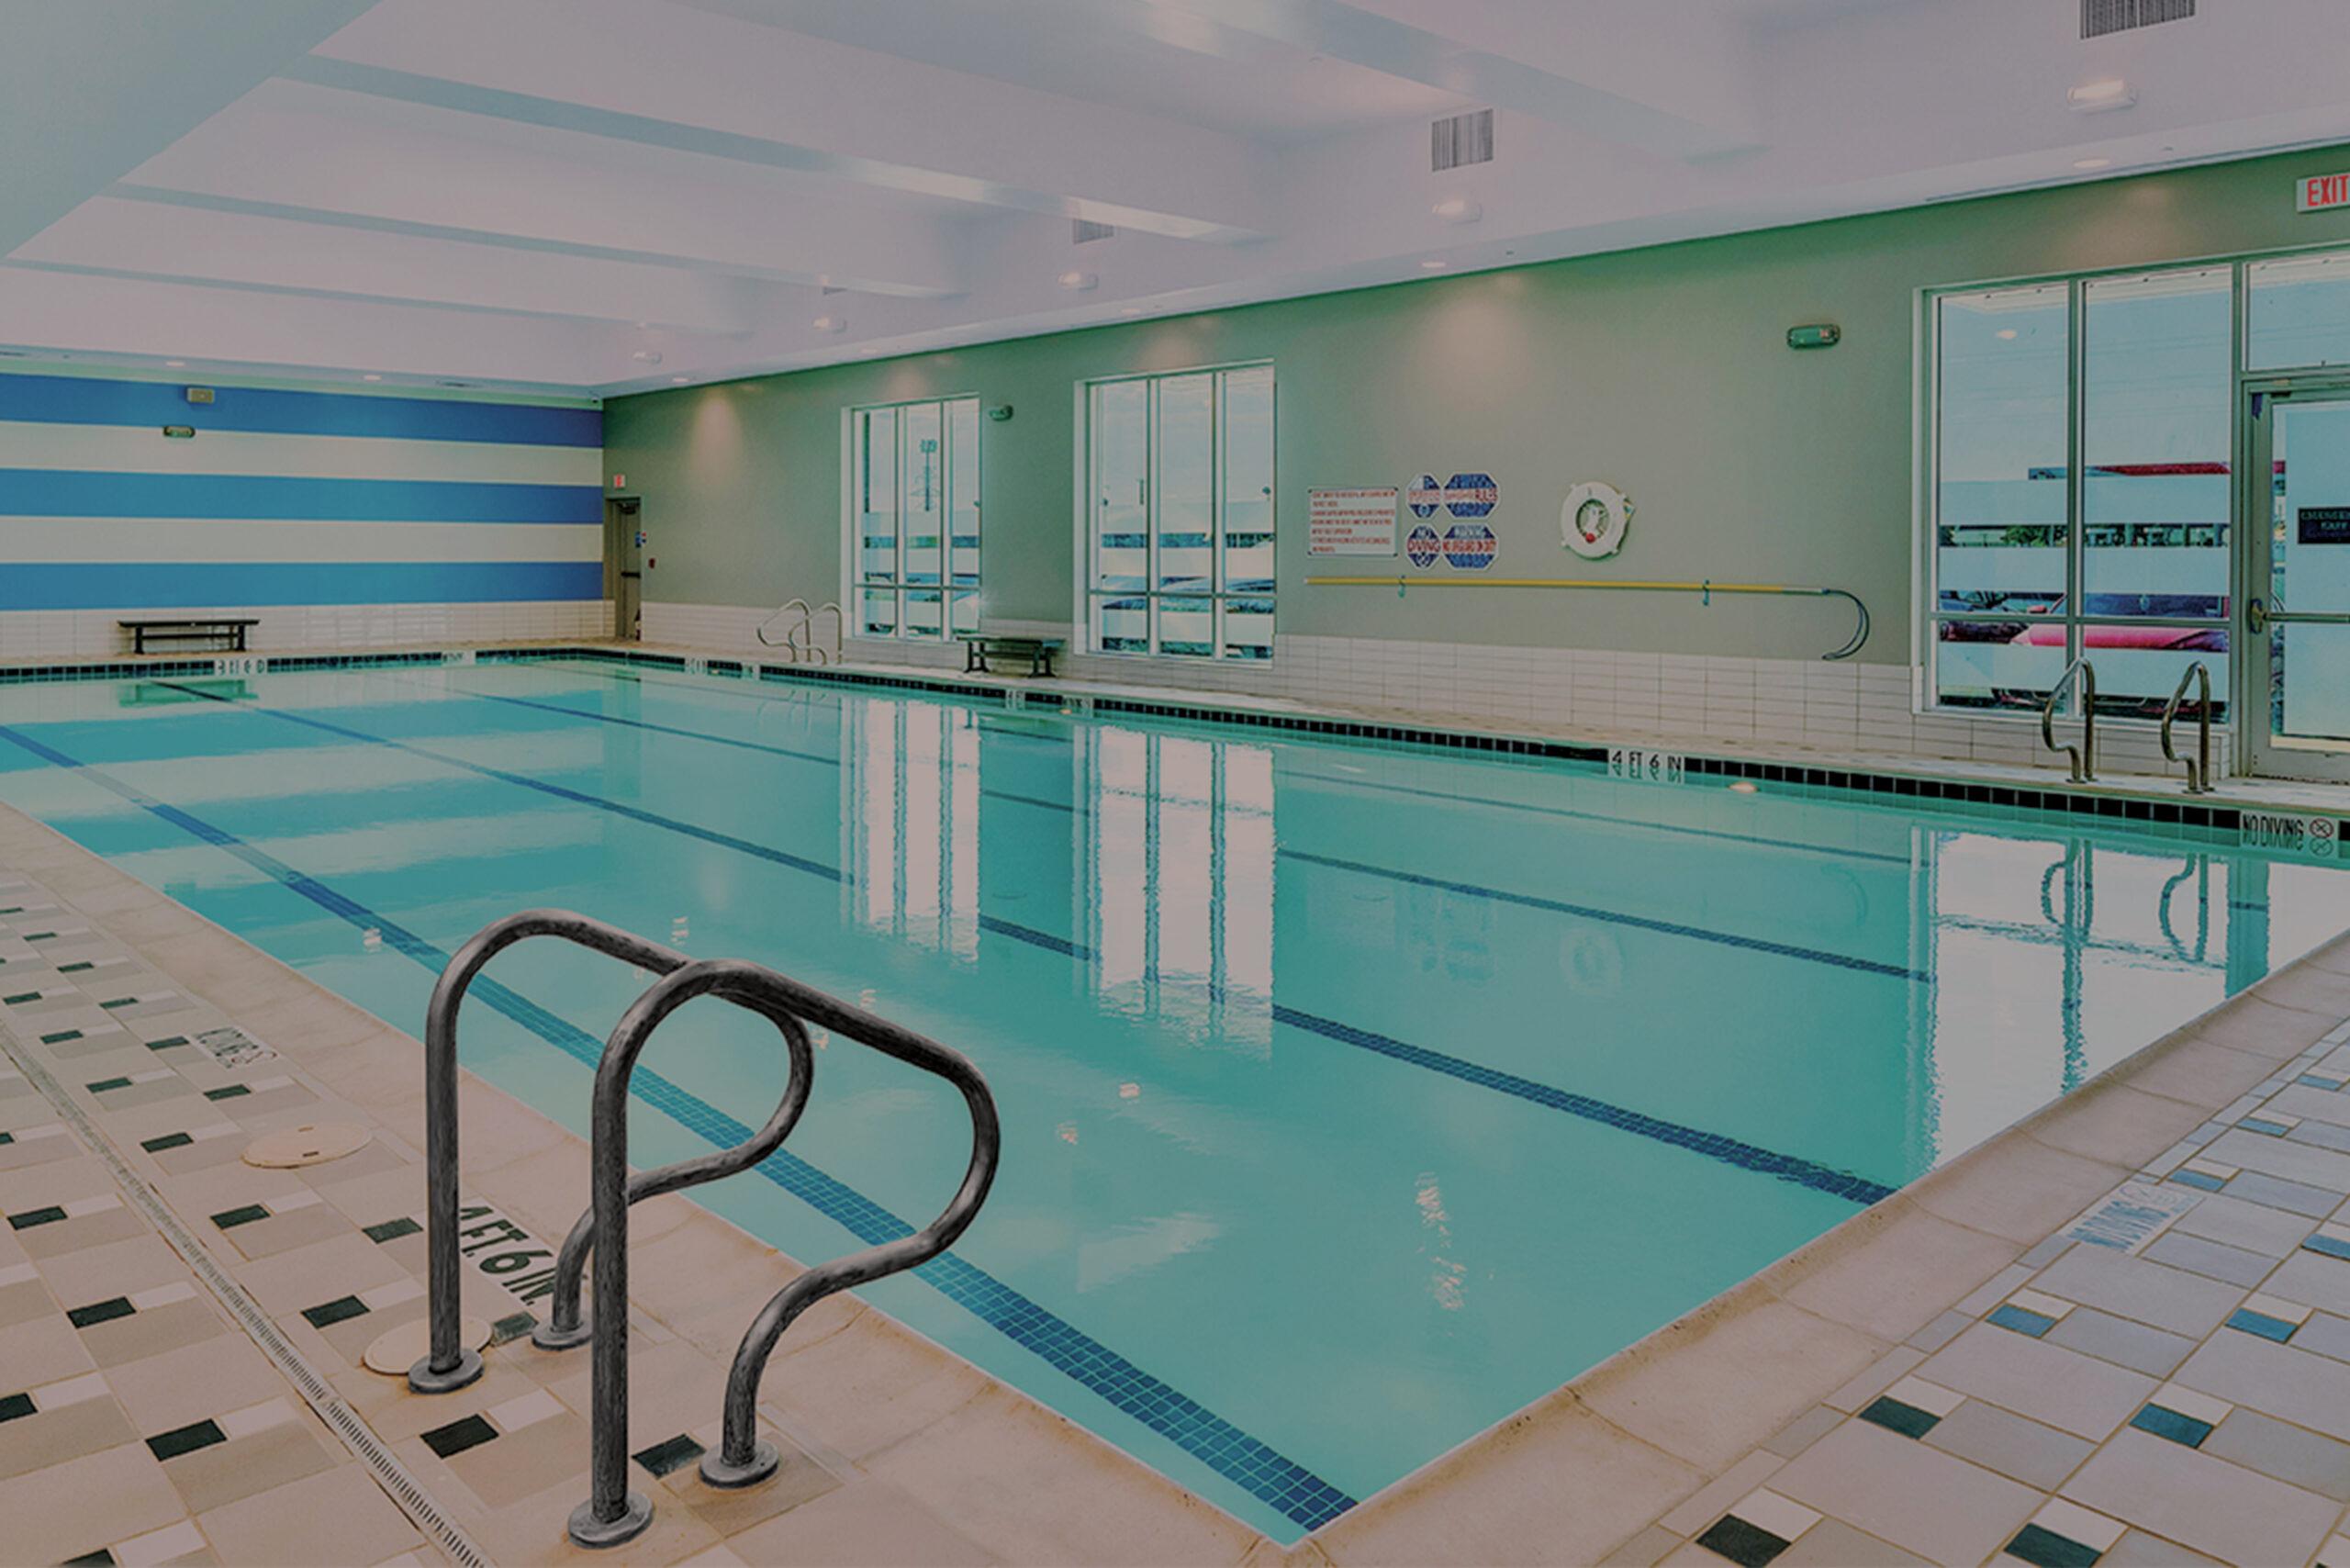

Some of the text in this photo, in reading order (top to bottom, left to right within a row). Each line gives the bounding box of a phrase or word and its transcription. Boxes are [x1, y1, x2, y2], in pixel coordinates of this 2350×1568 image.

[2307, 174, 2349, 207] EXIT
[2243, 813, 2304, 836] NO DIVING
[479, 1249, 554, 1274] 6
